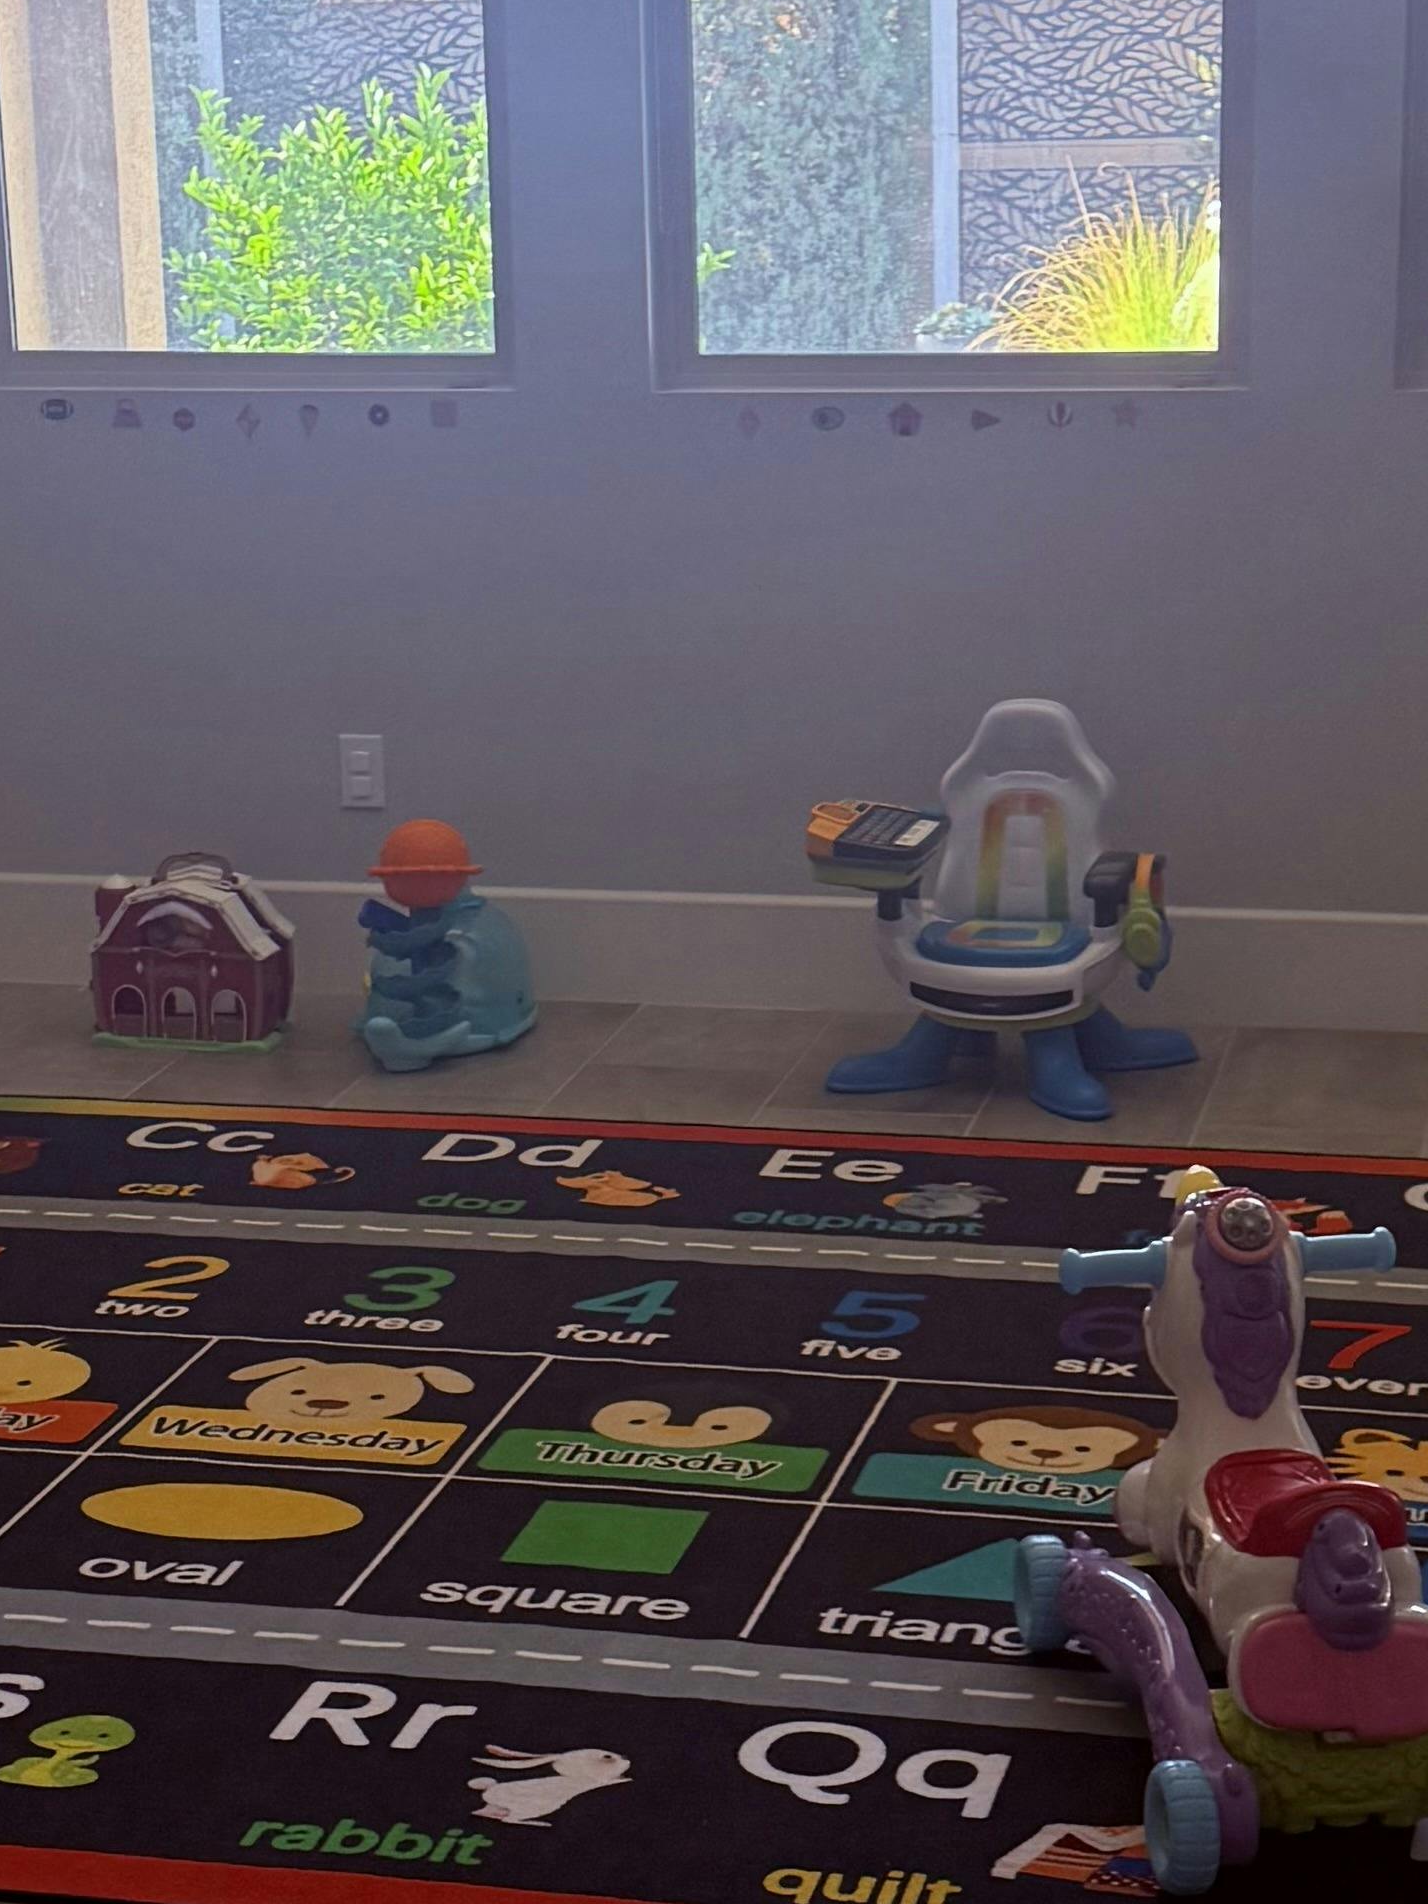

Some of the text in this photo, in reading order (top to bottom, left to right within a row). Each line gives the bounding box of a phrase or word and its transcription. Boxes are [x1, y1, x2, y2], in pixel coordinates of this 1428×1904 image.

[126, 1121, 275, 1153] Cc
[421, 1132, 603, 1168] Dd
[758, 1148, 904, 1184] Ee
[117, 1182, 204, 1197] cat
[416, 1191, 528, 1215] dog
[732, 1209, 985, 1238] elephant
[107, 1255, 230, 1301] 2
[344, 1266, 456, 1312] 3
[94, 1299, 190, 1319] two
[573, 1279, 680, 1325] 4
[819, 1290, 926, 1339] 5
[304, 1308, 444, 1333] three
[556, 1324, 671, 1346] four
[799, 1338, 903, 1362] five
[1310, 1319, 1412, 1370] 7
[1053, 1355, 1140, 1379] six
[147, 1416, 445, 1457] Wednesday
[534, 1440, 783, 1479] Thursday
[942, 1468, 1116, 1504] Friday
[78, 1552, 244, 1588] oval
[420, 1576, 691, 1623] square
[819, 1607, 1091, 1656] triang
[269, 1680, 477, 1750] Rr
[737, 1720, 1013, 1819] Qq
[239, 1816, 492, 1865] rabbit
